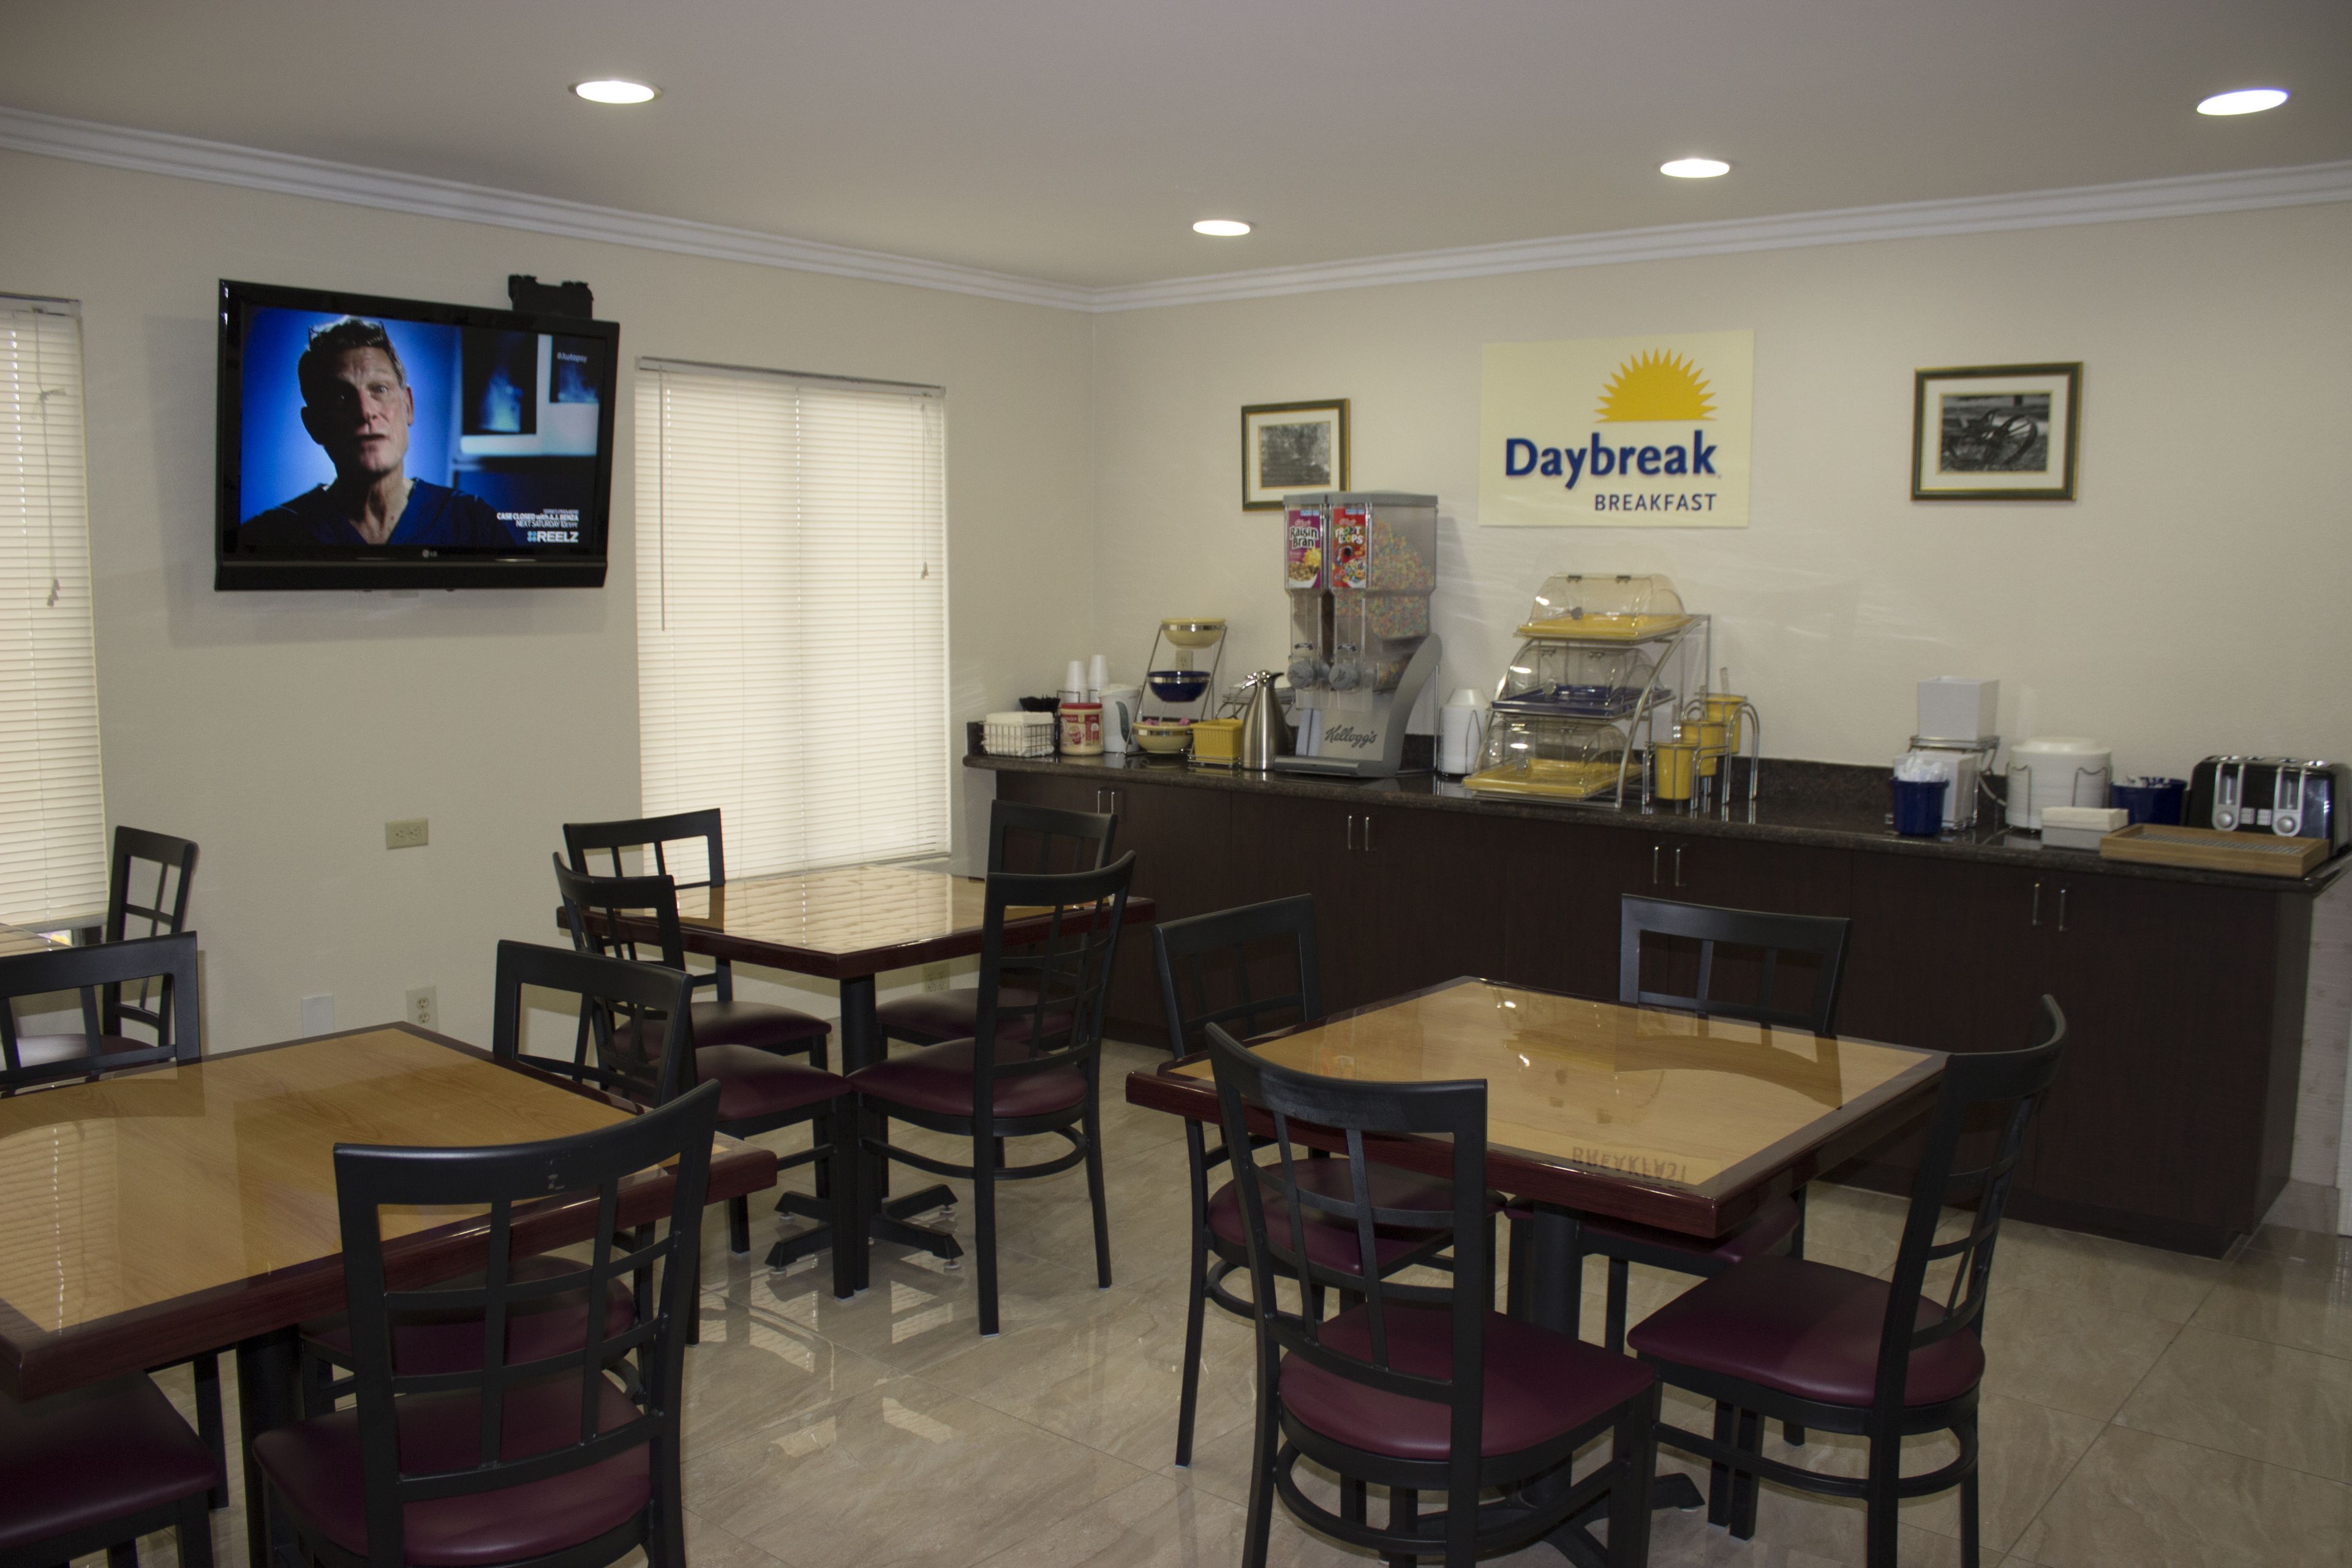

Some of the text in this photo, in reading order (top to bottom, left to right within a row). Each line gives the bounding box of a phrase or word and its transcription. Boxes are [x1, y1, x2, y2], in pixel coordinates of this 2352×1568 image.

[1506, 429, 1717, 490] Daybreak
[1594, 493, 1717, 511] BREAKFAST
[496, 512, 513, 521] CASE
[513, 512, 535, 521] CLOSED
[531, 519, 560, 528] SATURDAY
[537, 530, 579, 543] REELZ
[1290, 526, 1319, 540] Raisin
[1292, 537, 1316, 549] Bran
[1324, 724, 1378, 748] Kellogg's
